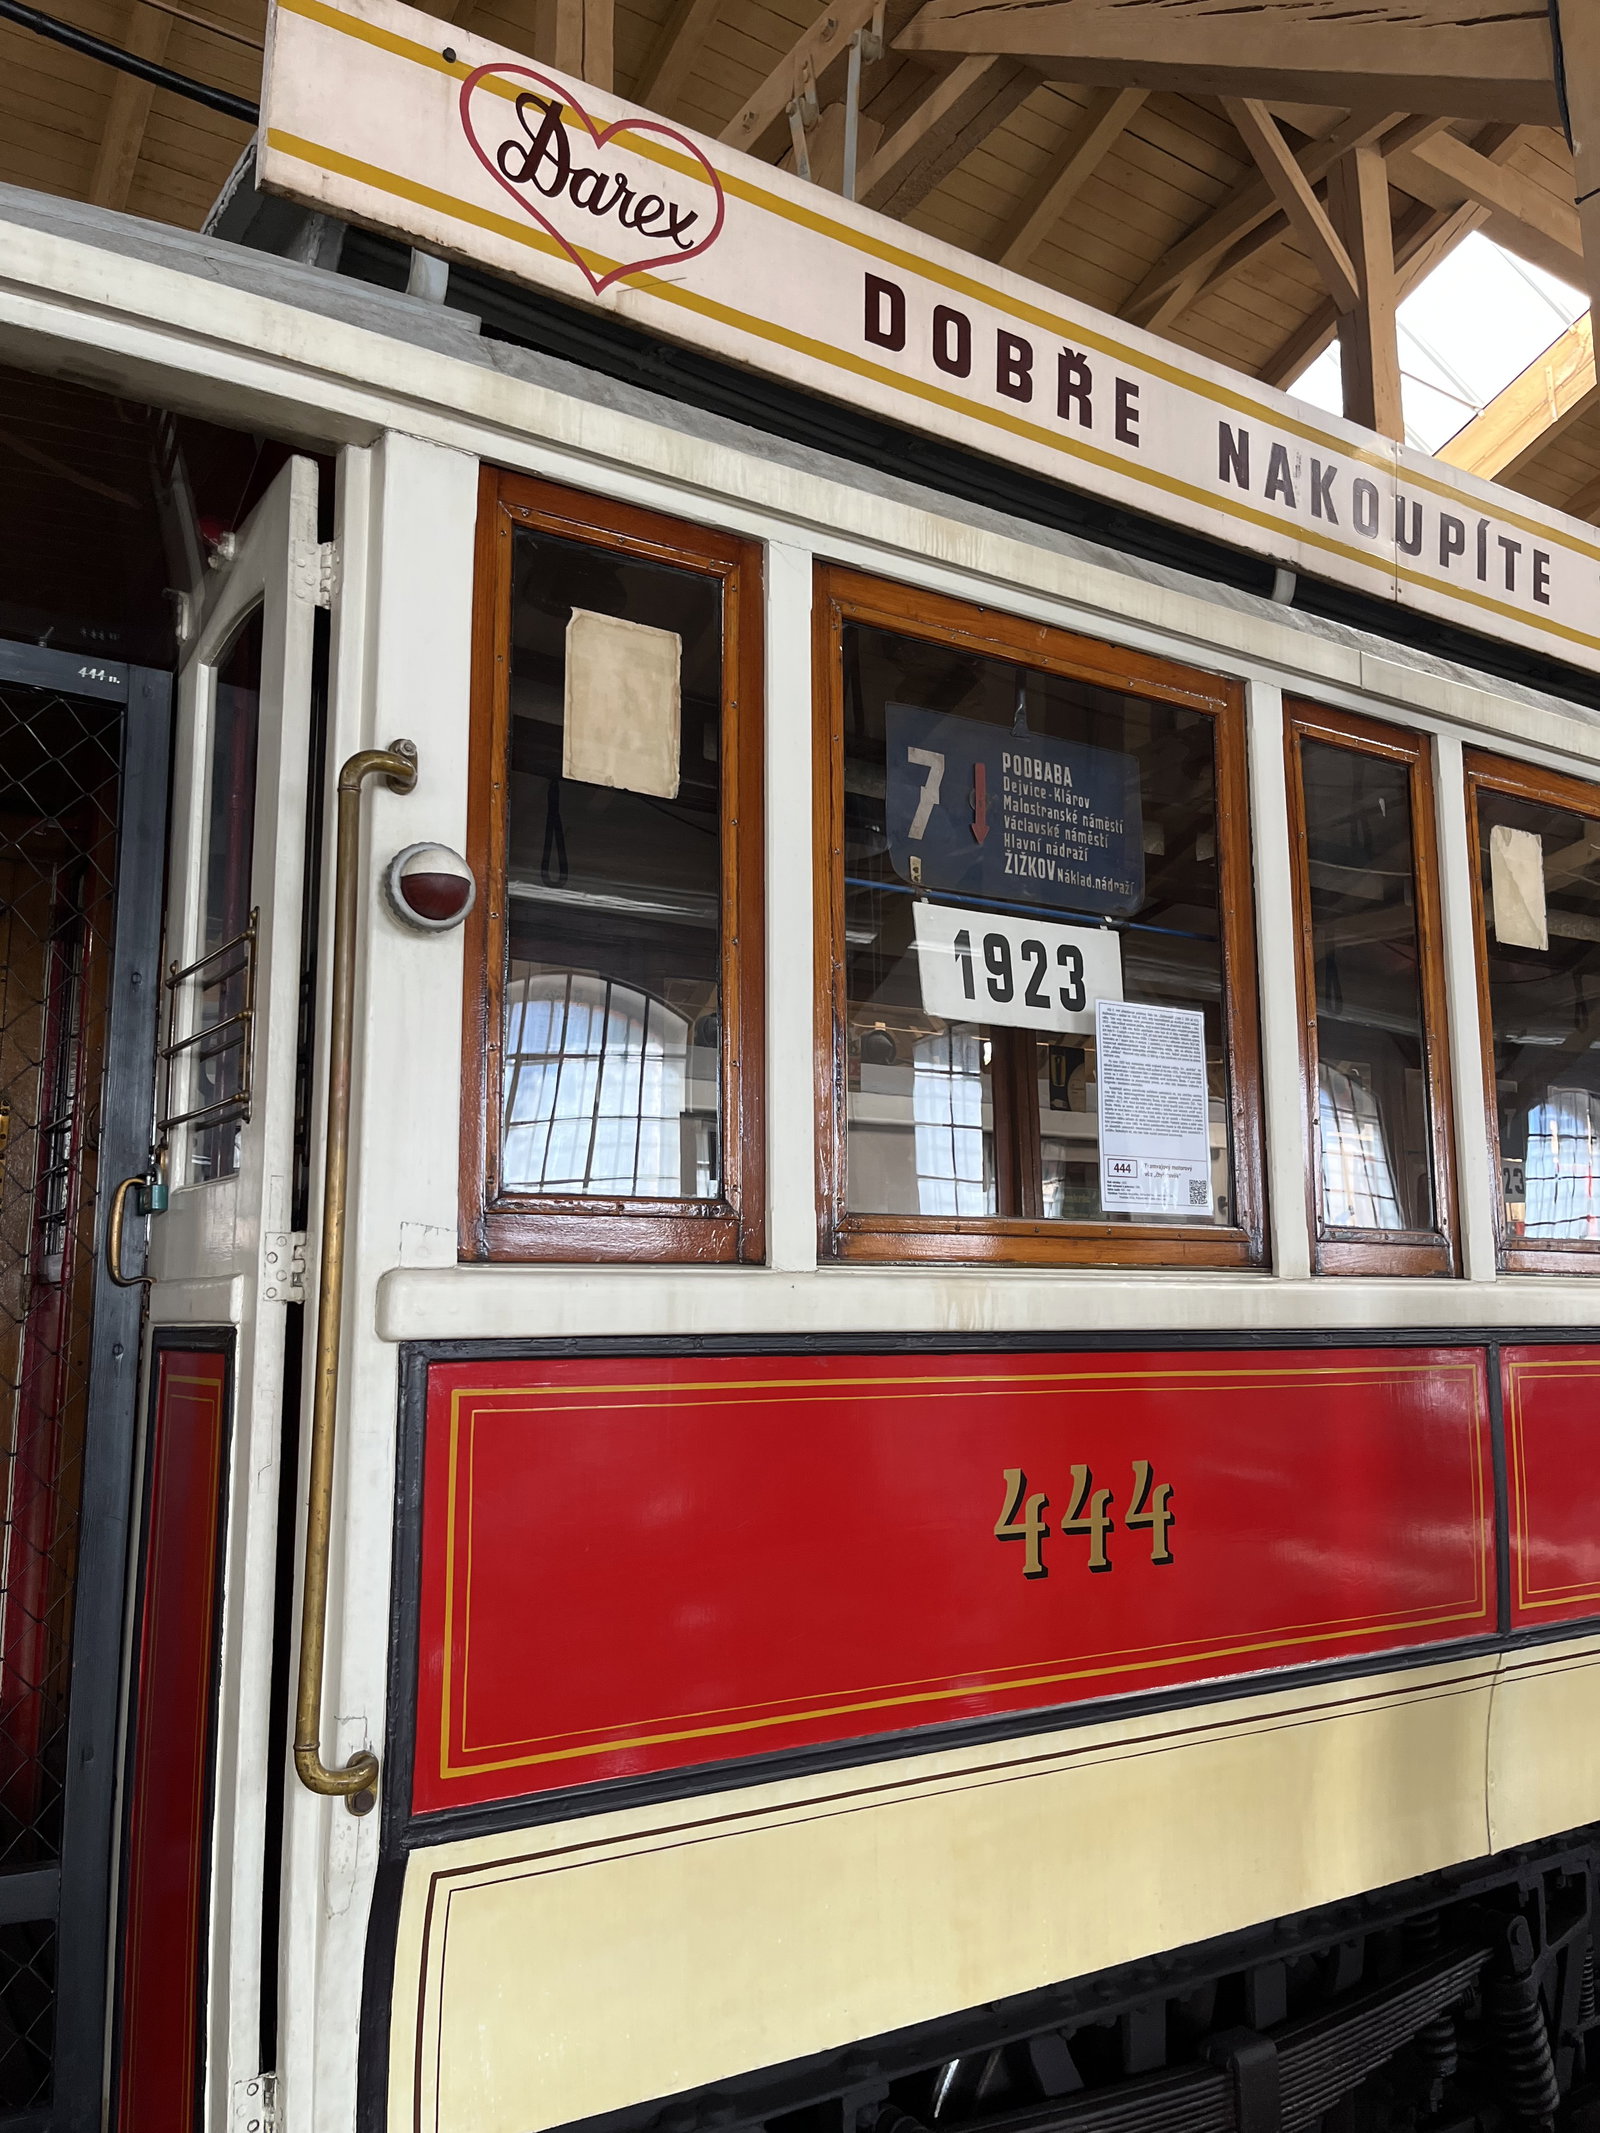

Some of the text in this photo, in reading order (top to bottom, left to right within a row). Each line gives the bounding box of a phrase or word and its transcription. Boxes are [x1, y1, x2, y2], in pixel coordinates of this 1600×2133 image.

[497, 92, 698, 250] Darex
[864, 272, 1551, 606] DOBŘE NAKOUPÍTE
[78, 667, 106, 681] 444
[1002, 752, 1073, 787] PODBABA
[907, 746, 945, 840] 7
[1003, 795, 1124, 834] Malostranské náměstí
[1004, 815, 1108, 849] Václavské náměstí
[1004, 833, 1088, 862] Hlavní nádraží
[1004, 853, 1056, 881] ŽIŽKOV
[955, 929, 1086, 1013] 1923
[1113, 1162, 1132, 1174] 444
[993, 1460, 1176, 1580] 444
